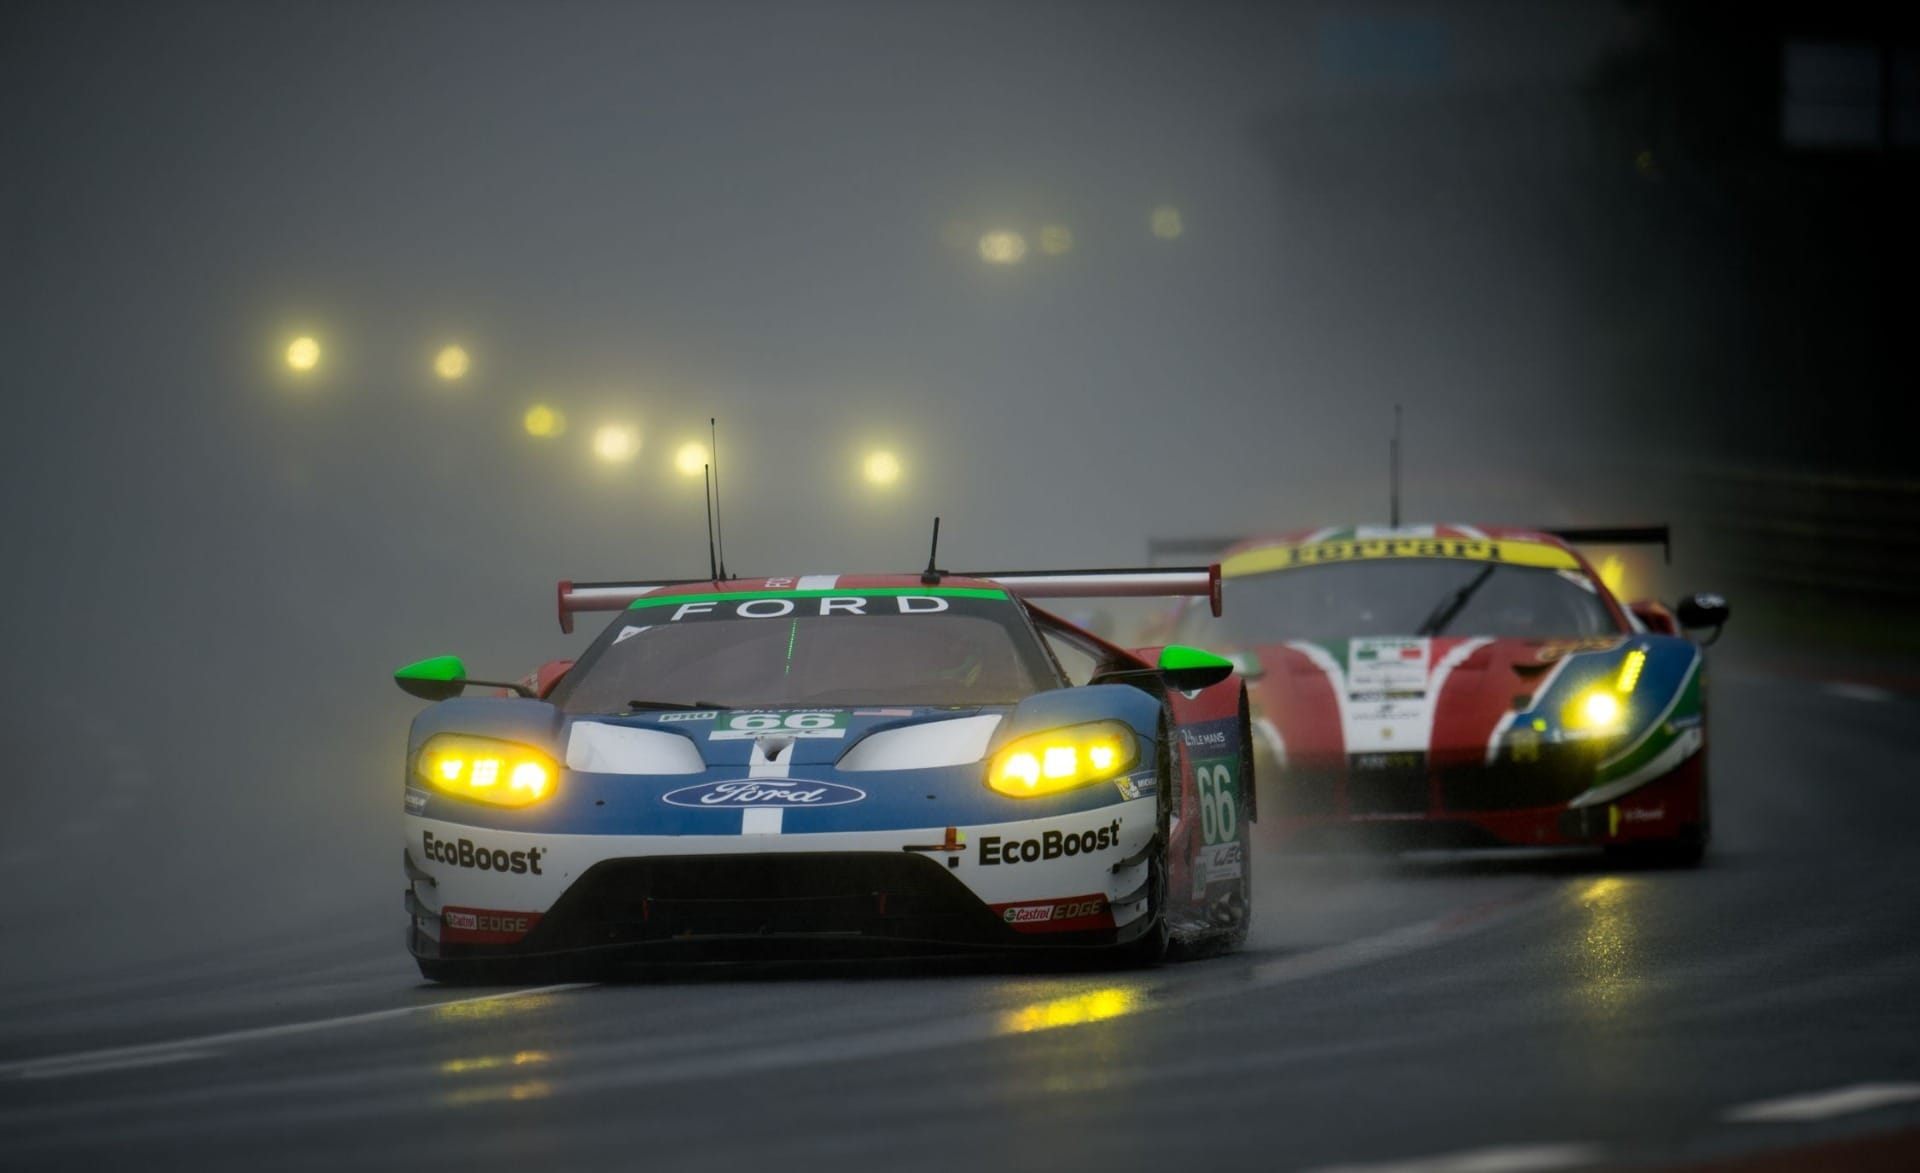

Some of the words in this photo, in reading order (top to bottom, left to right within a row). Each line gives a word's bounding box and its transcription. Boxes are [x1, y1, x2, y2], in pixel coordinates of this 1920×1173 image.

[1286, 538, 1502, 564] Ferrari
[670, 595, 950, 622] FORD
[729, 713, 836, 730] 66
[1203, 731, 1226, 745] MANS
[700, 779, 828, 804] Ford
[1197, 763, 1237, 845] 66
[422, 829, 542, 875] EcoBoost
[978, 817, 1120, 867] EcoBoost
[1015, 907, 1050, 921] Castrol
[1052, 900, 1102, 920] EDGE
[478, 915, 529, 933] EDGE
